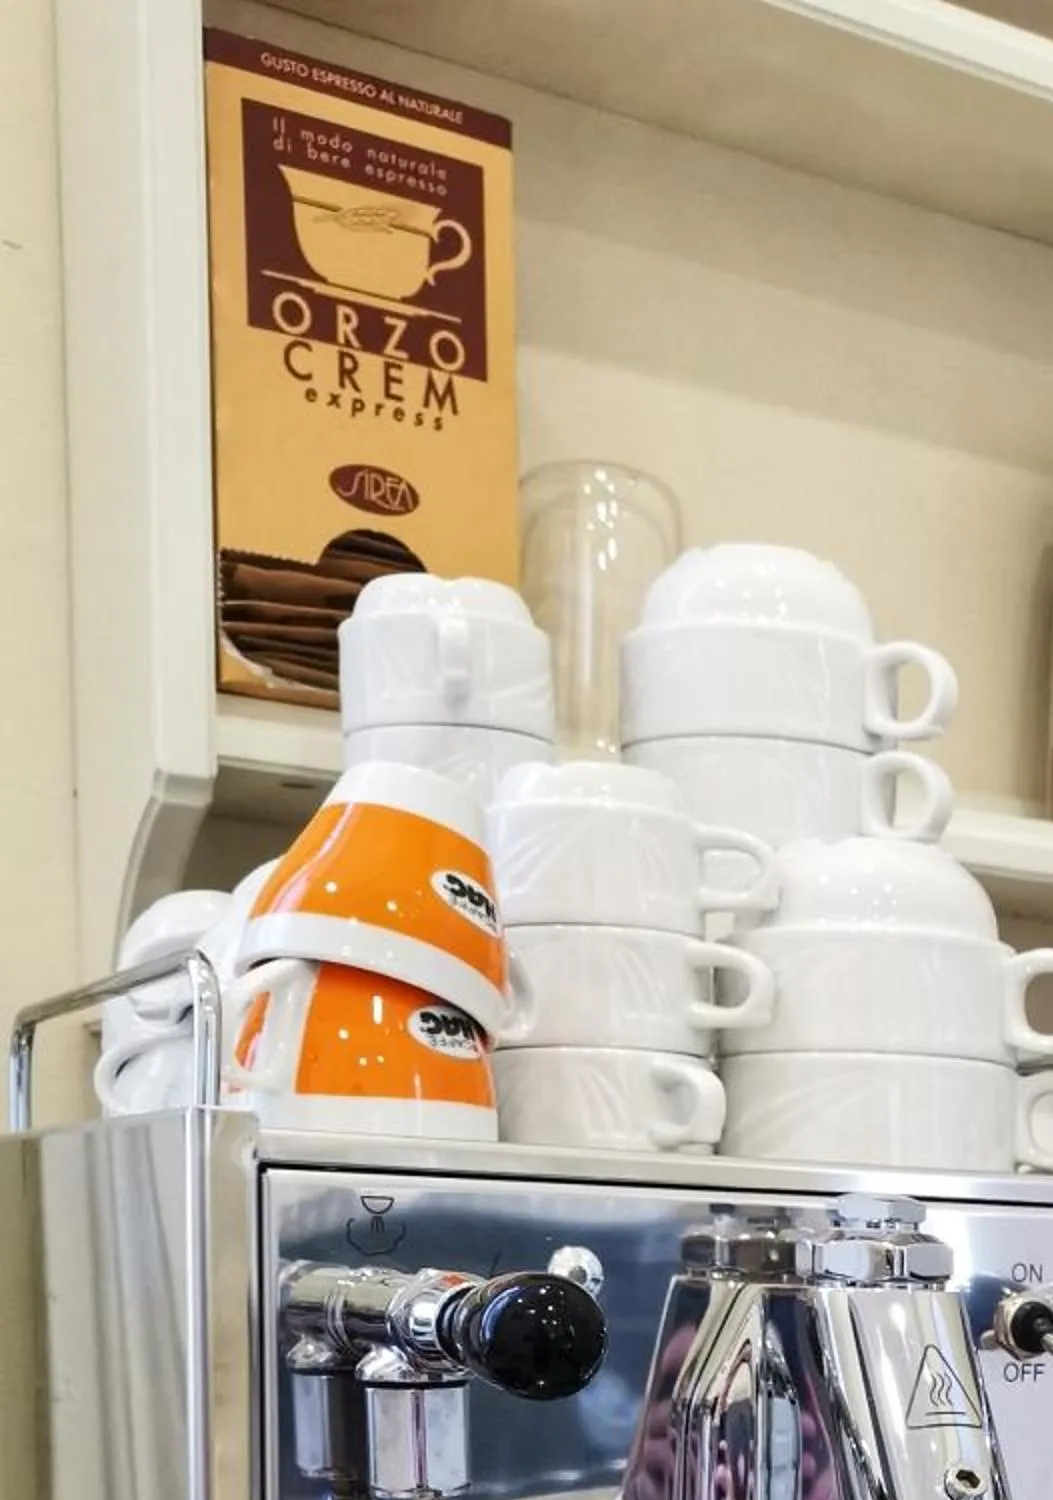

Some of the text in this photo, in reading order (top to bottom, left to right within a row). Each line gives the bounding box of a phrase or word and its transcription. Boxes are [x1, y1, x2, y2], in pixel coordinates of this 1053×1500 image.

[260, 52, 463, 126] GUSTO ESPRESSO AL NATURALE
[273, 135, 448, 196] di bere espresso
[301, 128, 353, 154] modo
[367, 146, 447, 181] naturale
[272, 291, 465, 372] ORZO
[283, 340, 459, 416] CREM
[304, 387, 444, 432] express
[1010, 1262, 1044, 1284] ON
[1003, 1363, 1045, 1384] OFF
